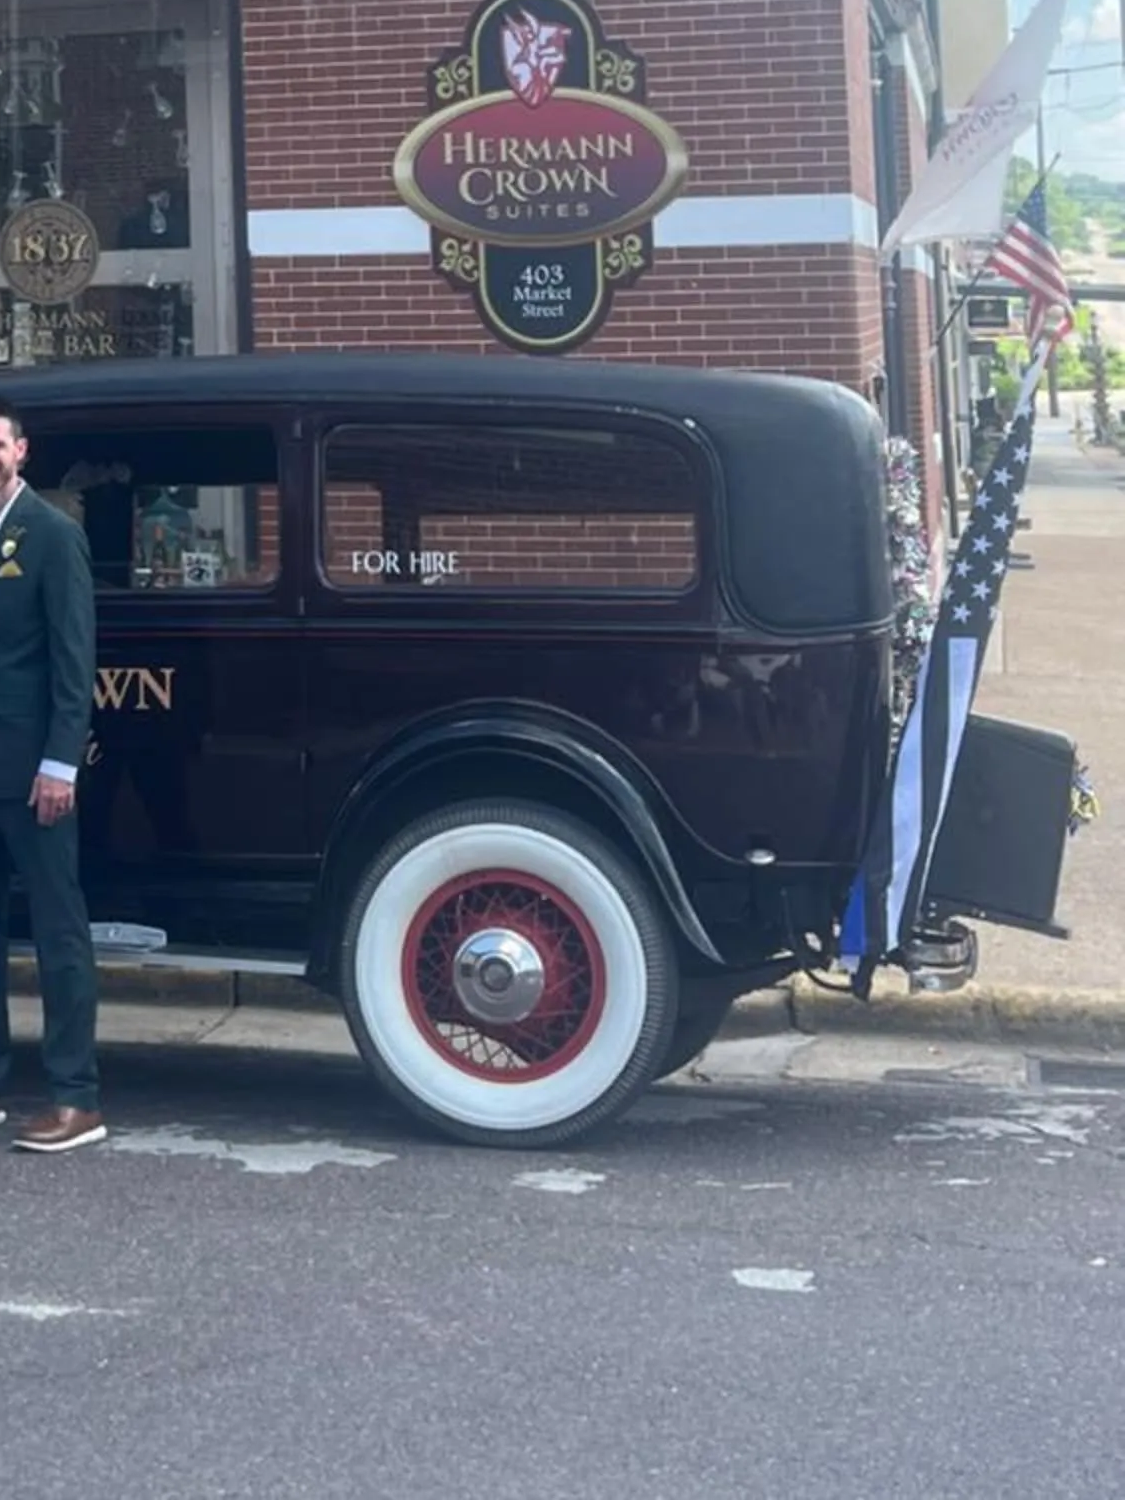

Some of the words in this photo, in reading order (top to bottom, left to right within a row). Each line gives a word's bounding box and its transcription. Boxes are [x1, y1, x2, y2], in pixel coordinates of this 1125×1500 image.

[442, 131, 633, 168] HERMANN
[458, 164, 619, 205] CROWN
[486, 202, 590, 220] SUITES
[11, 233, 88, 263] 1837
[520, 265, 564, 285] 403
[513, 286, 572, 302] Market
[522, 303, 564, 318] Street
[64, 334, 116, 357] BAR
[351, 550, 401, 575] FOR
[410, 550, 460, 575] HIRE
